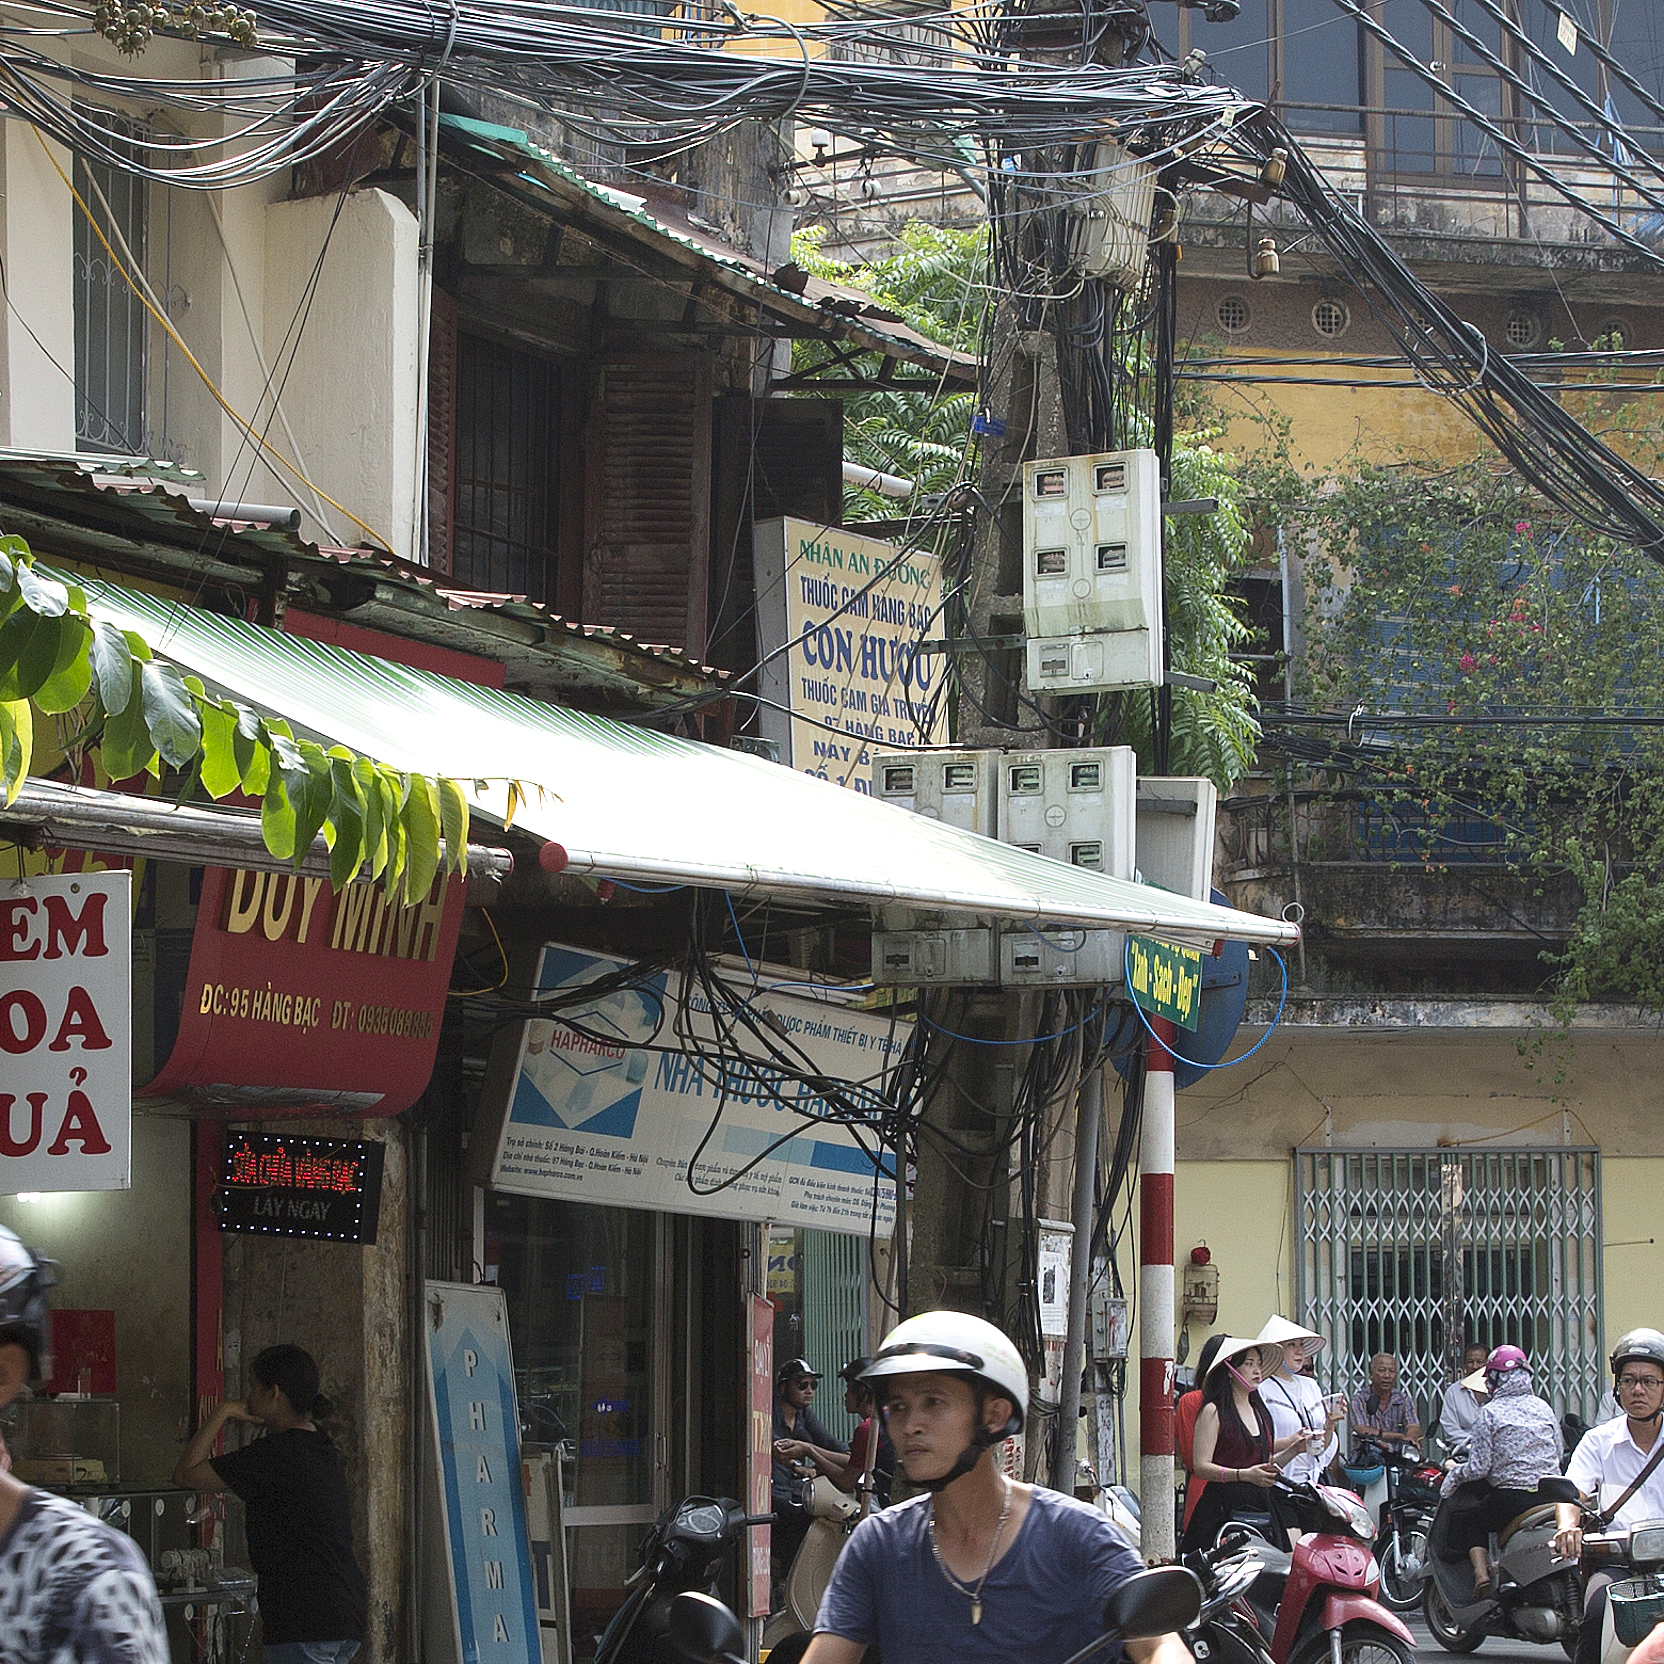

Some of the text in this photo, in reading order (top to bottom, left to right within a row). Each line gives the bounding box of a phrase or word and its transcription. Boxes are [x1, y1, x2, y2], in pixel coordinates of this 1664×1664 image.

[800, 539, 843, 569] NHÂN
[848, 551, 870, 576] AN
[800, 572, 838, 612] THUỐC
[841, 585, 868, 619] CAM
[872, 589, 905, 626] HÀNG
[802, 620, 853, 675] CON
[801, 676, 836, 706] THUỐC
[841, 687, 868, 713] CAM
[871, 694, 891, 718] GIA
[813, 741, 851, 763] NAY
[227, 869, 323, 944] DUY
[251, 981, 291, 1025] HÀNG
[292, 995, 321, 1035] BẠC
[550, 1029, 626, 1060] HAPHARCO
[803, 1014, 832, 1039] PHẨM
[833, 1023, 858, 1045] THIẾT
[858, 1033, 868, 1052] BỊ
[869, 1037, 877, 1047] Y
[655, 1045, 705, 1096] NHÀ
[287, 1199, 332, 1222] NGAY
